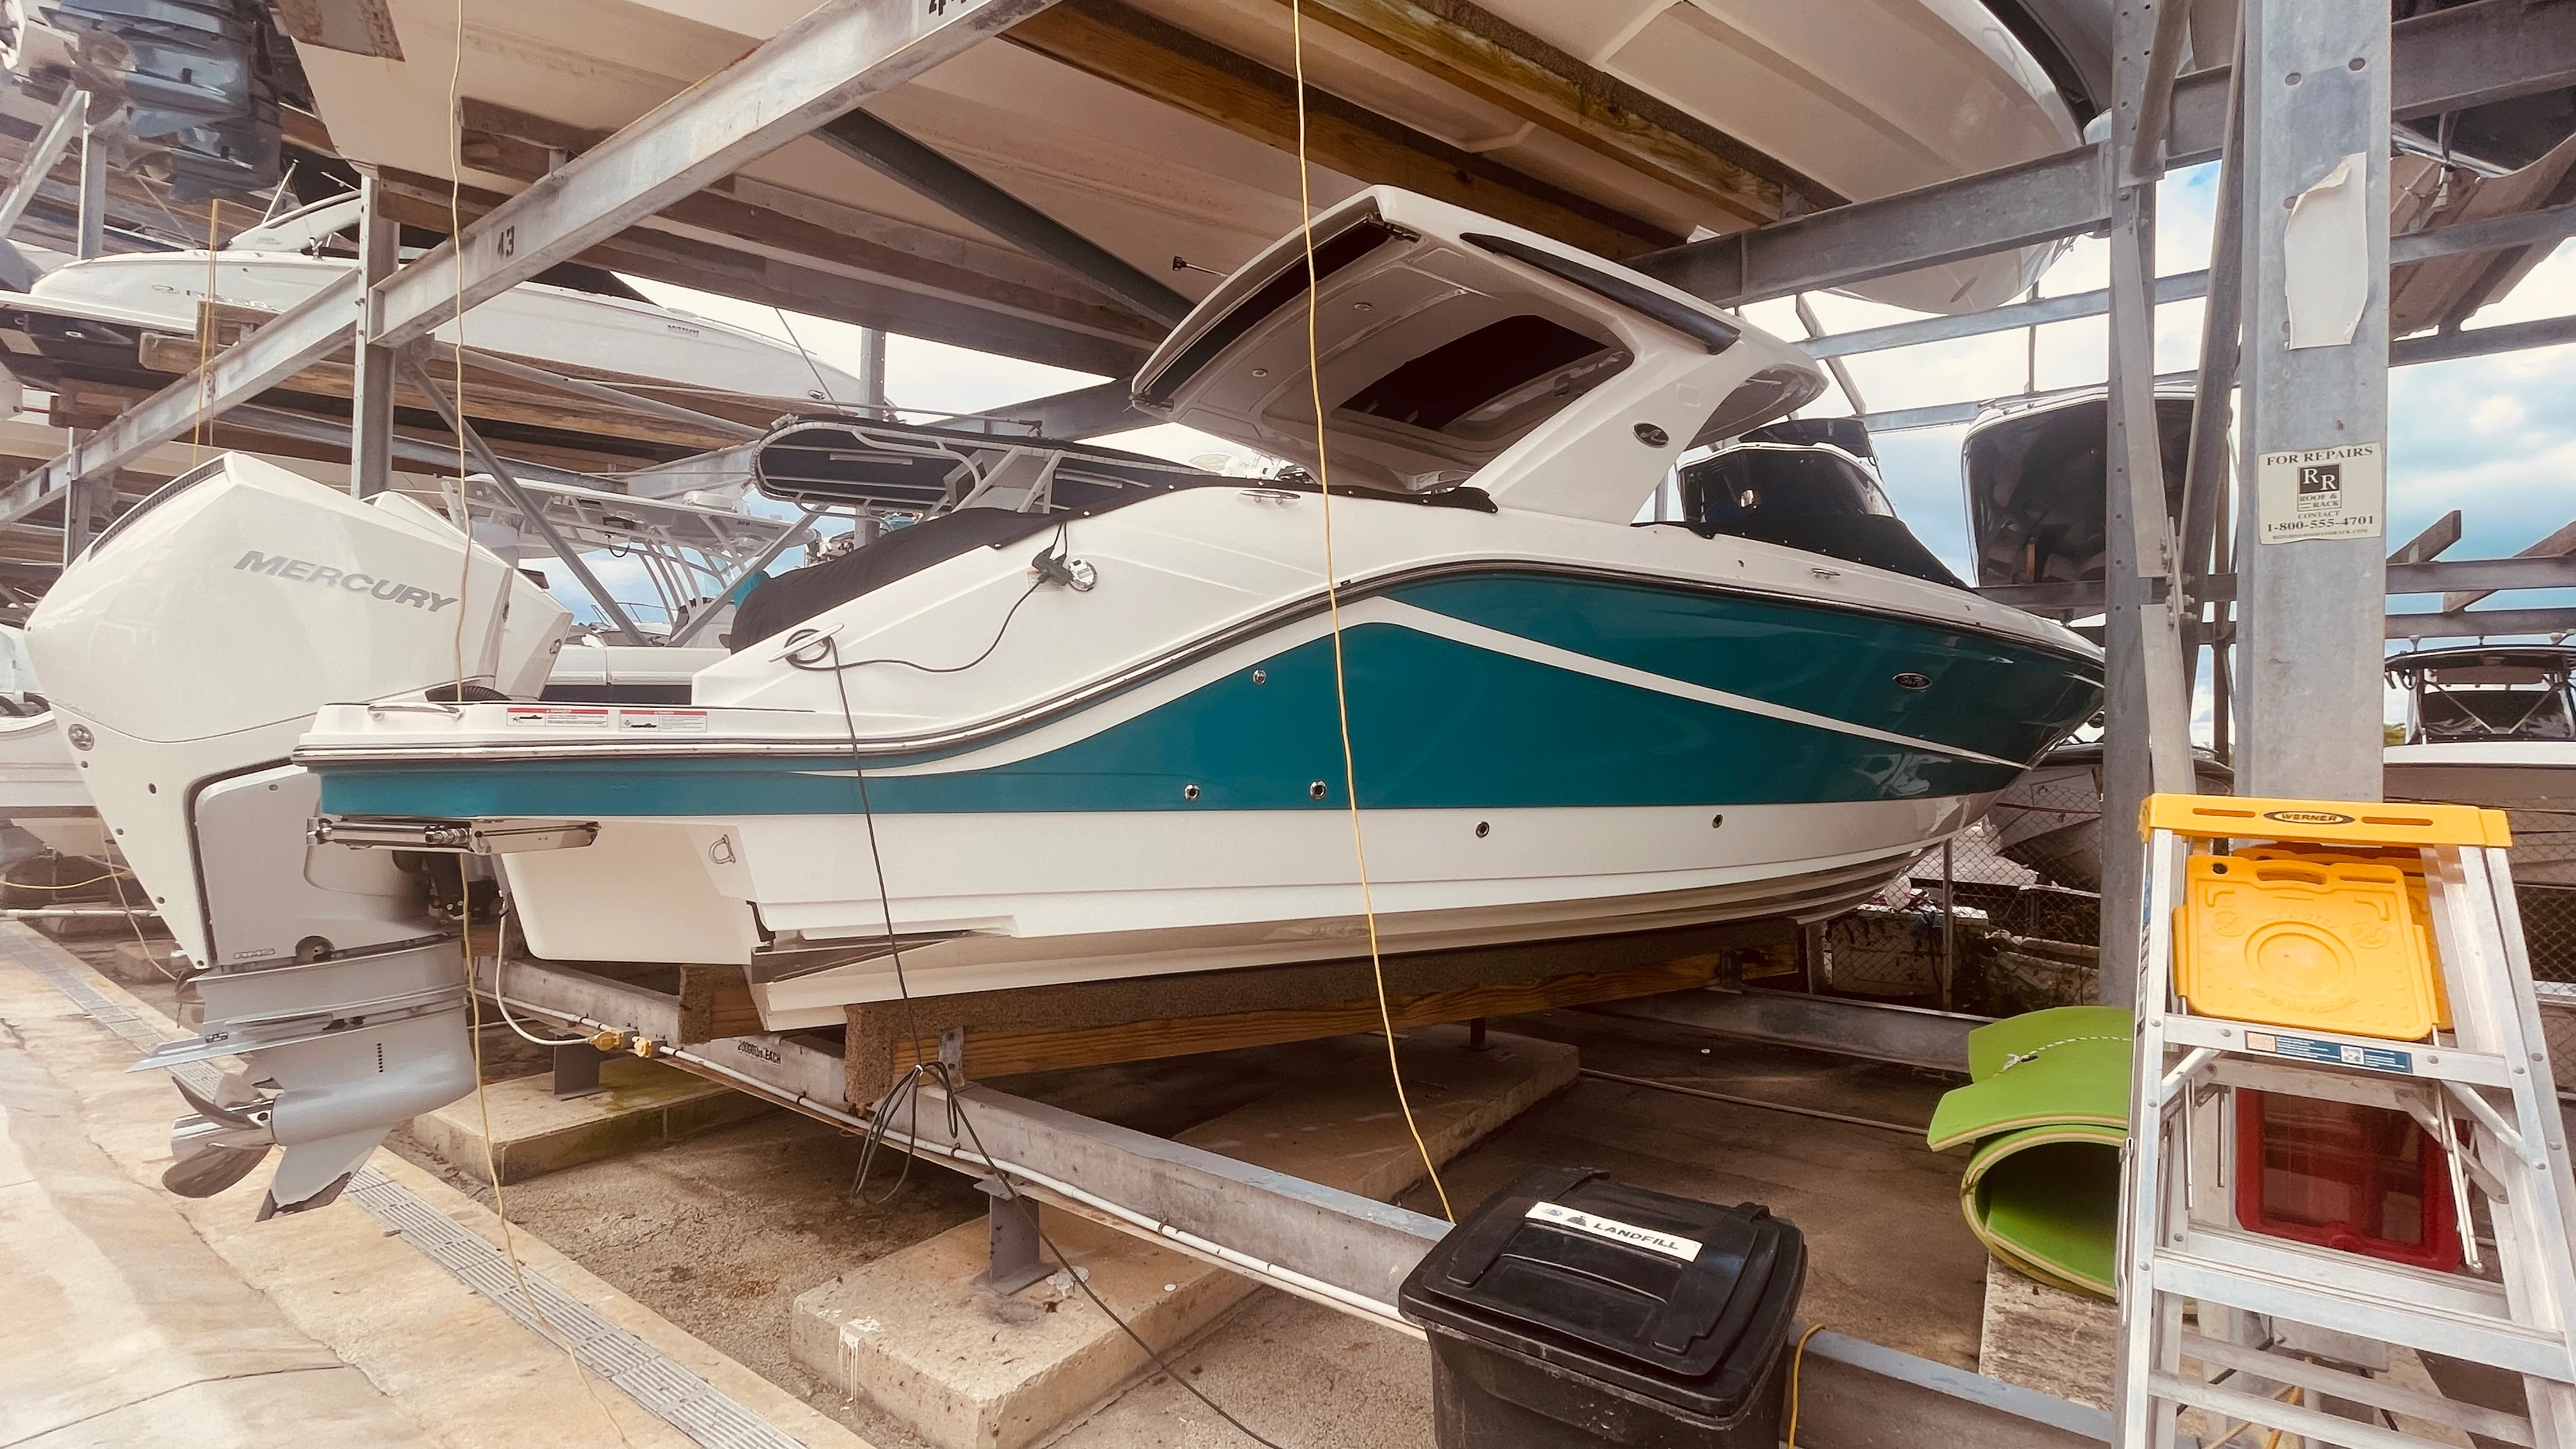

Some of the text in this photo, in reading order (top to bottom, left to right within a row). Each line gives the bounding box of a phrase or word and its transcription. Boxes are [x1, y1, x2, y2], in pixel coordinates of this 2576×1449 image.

[2267, 447, 2373, 466] FOR REPAIRS
[2297, 510, 2341, 519] CONTACT
[2268, 516, 2374, 532] 1-800-555-4701
[233, 551, 458, 612] MERCURY
[2281, 813, 2336, 822] WERNER
[1593, 1223, 1679, 1250] LANDFILL
